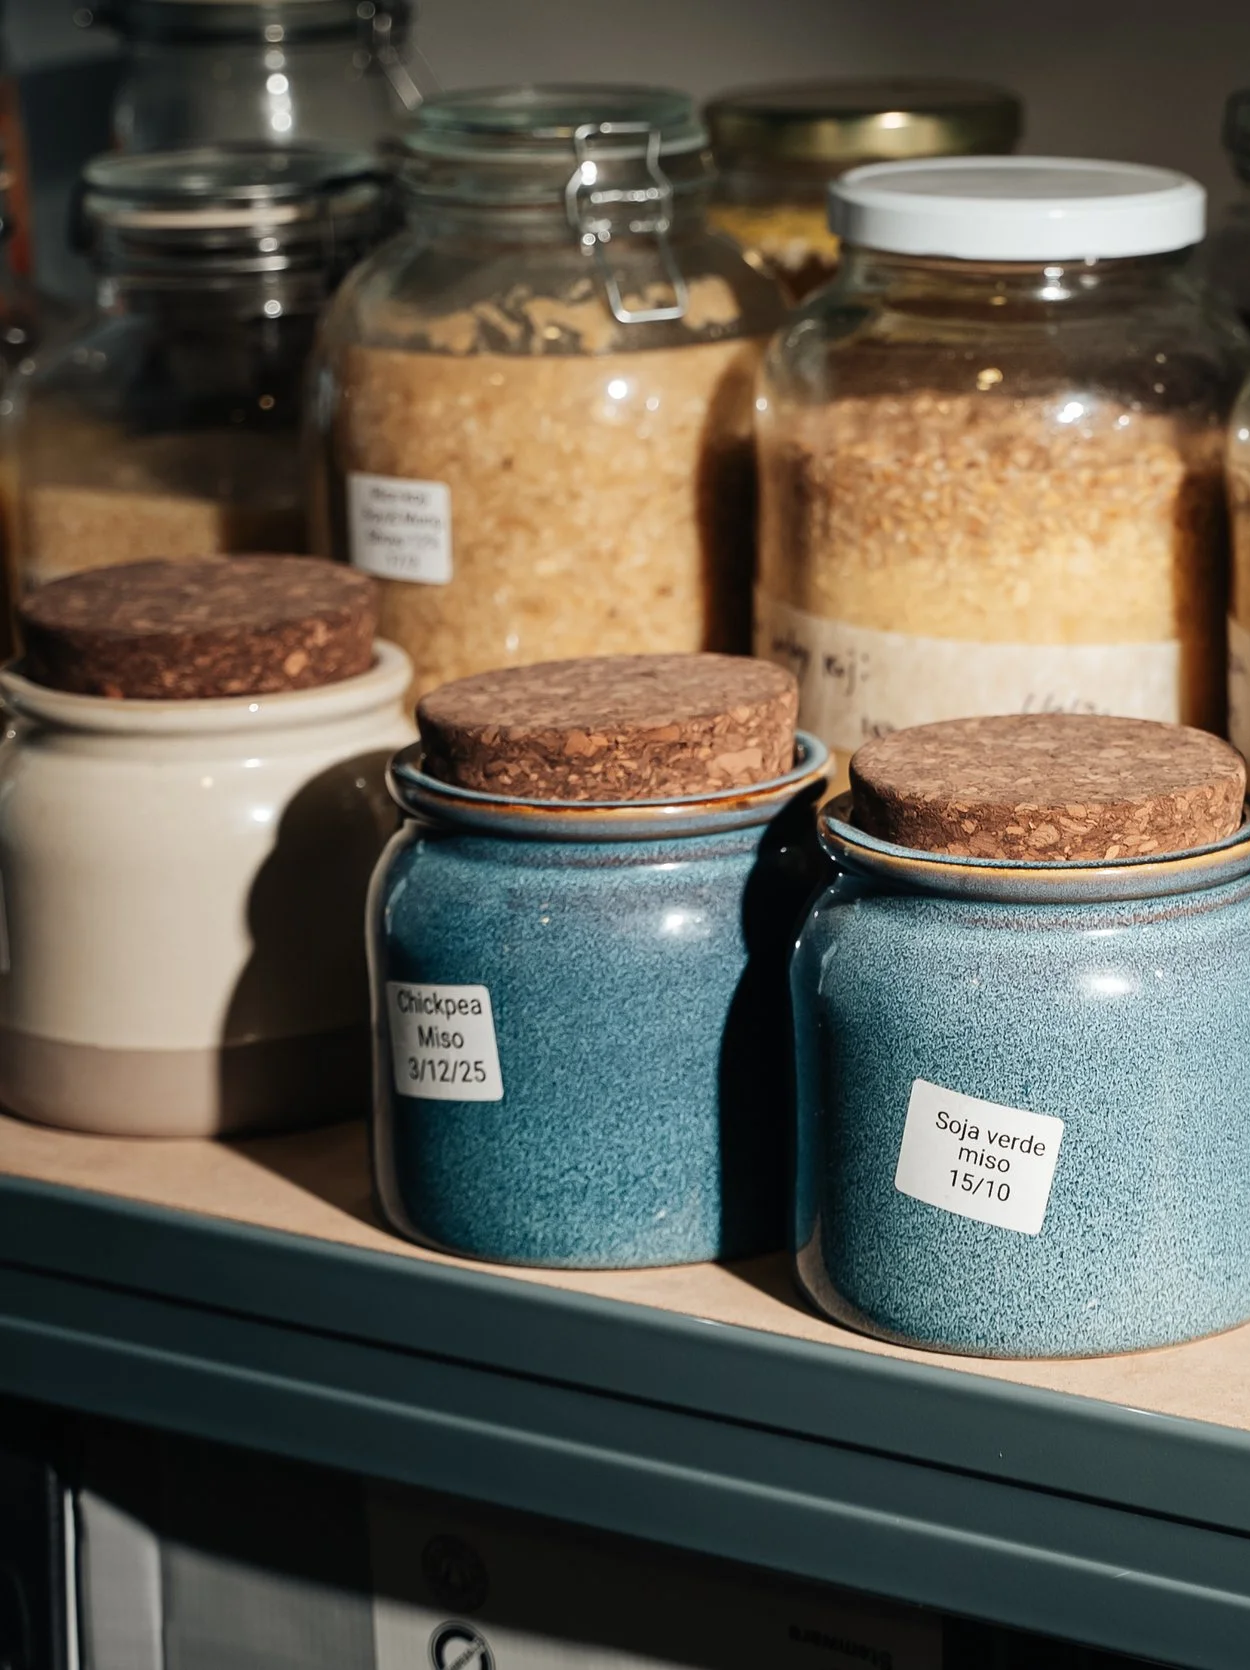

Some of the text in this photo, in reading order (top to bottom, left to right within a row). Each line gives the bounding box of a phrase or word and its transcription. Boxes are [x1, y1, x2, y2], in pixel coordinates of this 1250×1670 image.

[397, 989, 482, 1020] Chickpea
[418, 1025, 464, 1049] Miso
[408, 1056, 487, 1083] 3/12/25
[935, 1111, 1046, 1156] Soja verde
[958, 1147, 1010, 1173] miso
[950, 1170, 1011, 1202] 15/10
